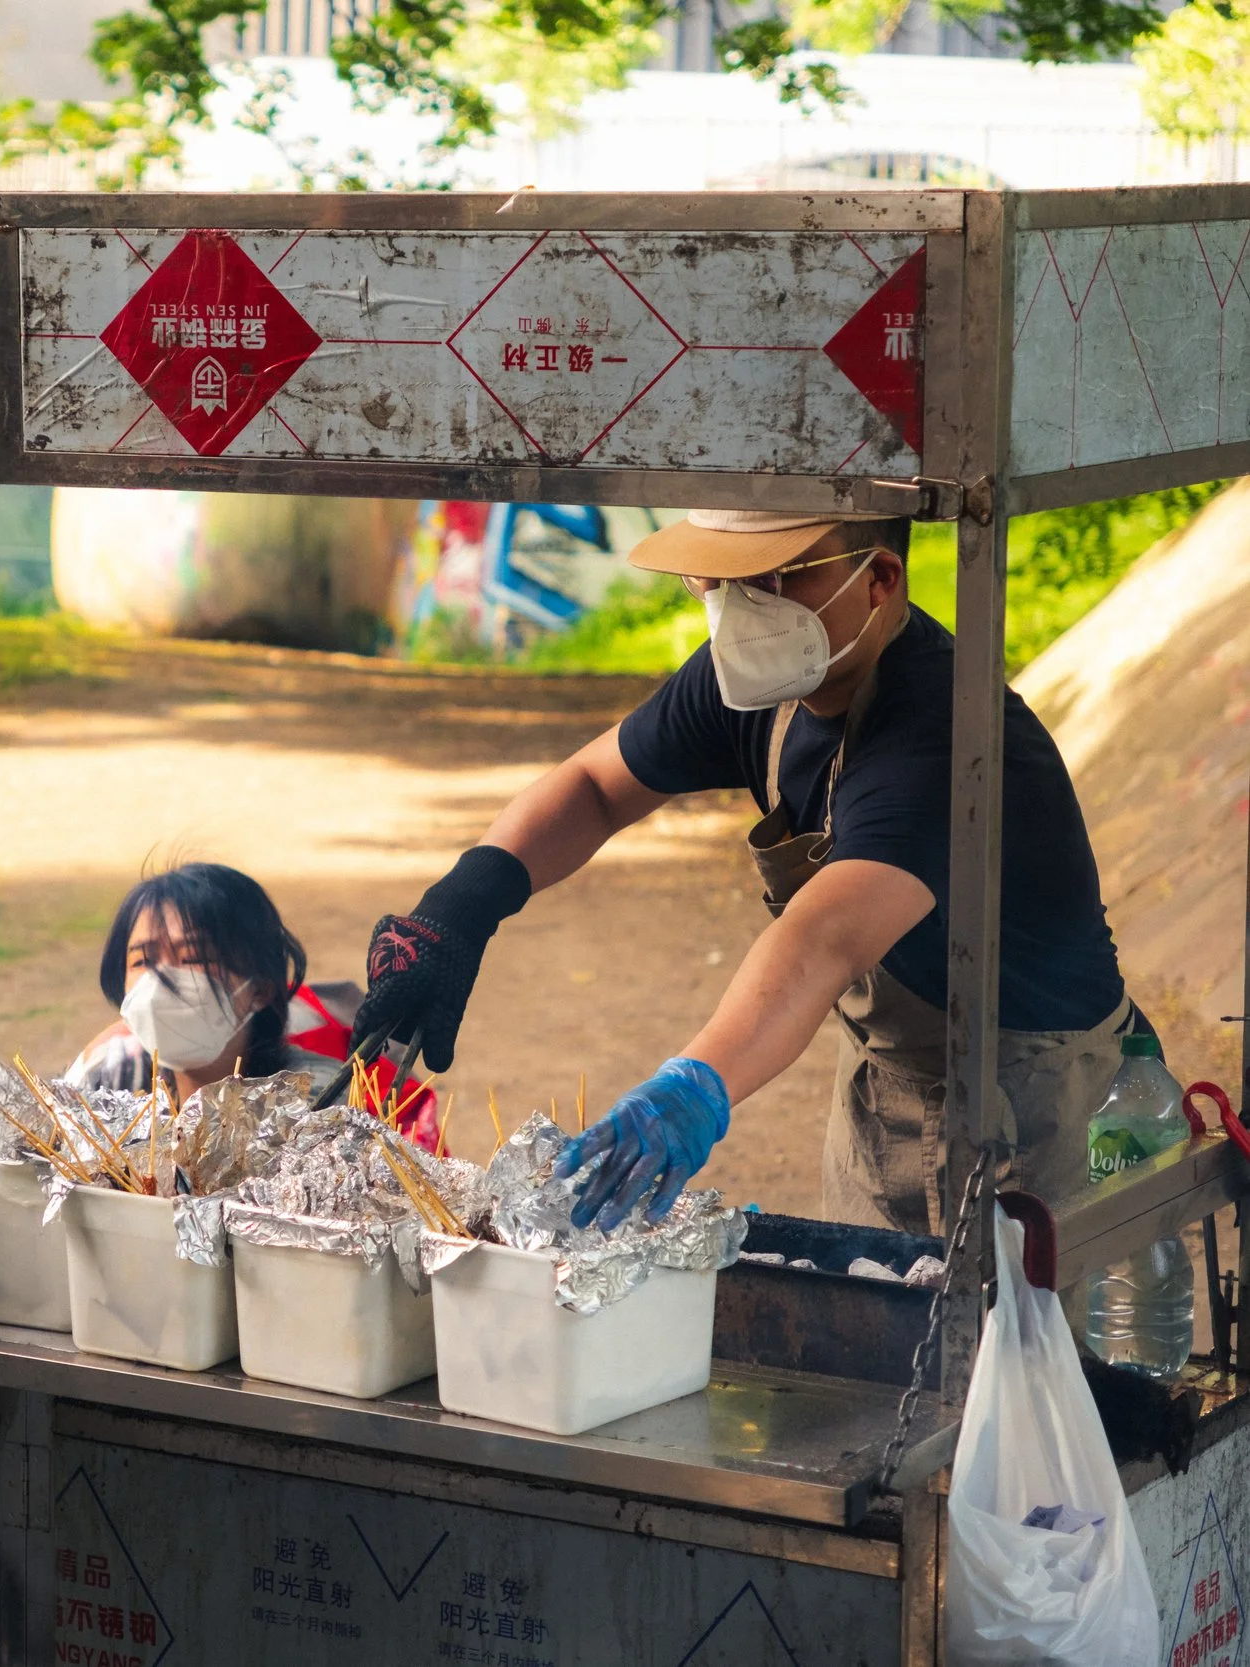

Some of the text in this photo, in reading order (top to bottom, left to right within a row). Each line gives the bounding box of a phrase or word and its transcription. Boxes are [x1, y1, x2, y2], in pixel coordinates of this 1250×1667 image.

[150, 303, 270, 316] JIN SEN STEEL
[151, 317, 267, 350] 金森钢业
[501, 343, 628, 374] 一级正材
[1090, 1147, 1139, 1172] Volvi
[274, 1537, 332, 1571] 避免
[252, 1566, 354, 1610] 阳光直射
[462, 1571, 524, 1606] 避免
[439, 1600, 547, 1645] 阳光直射
